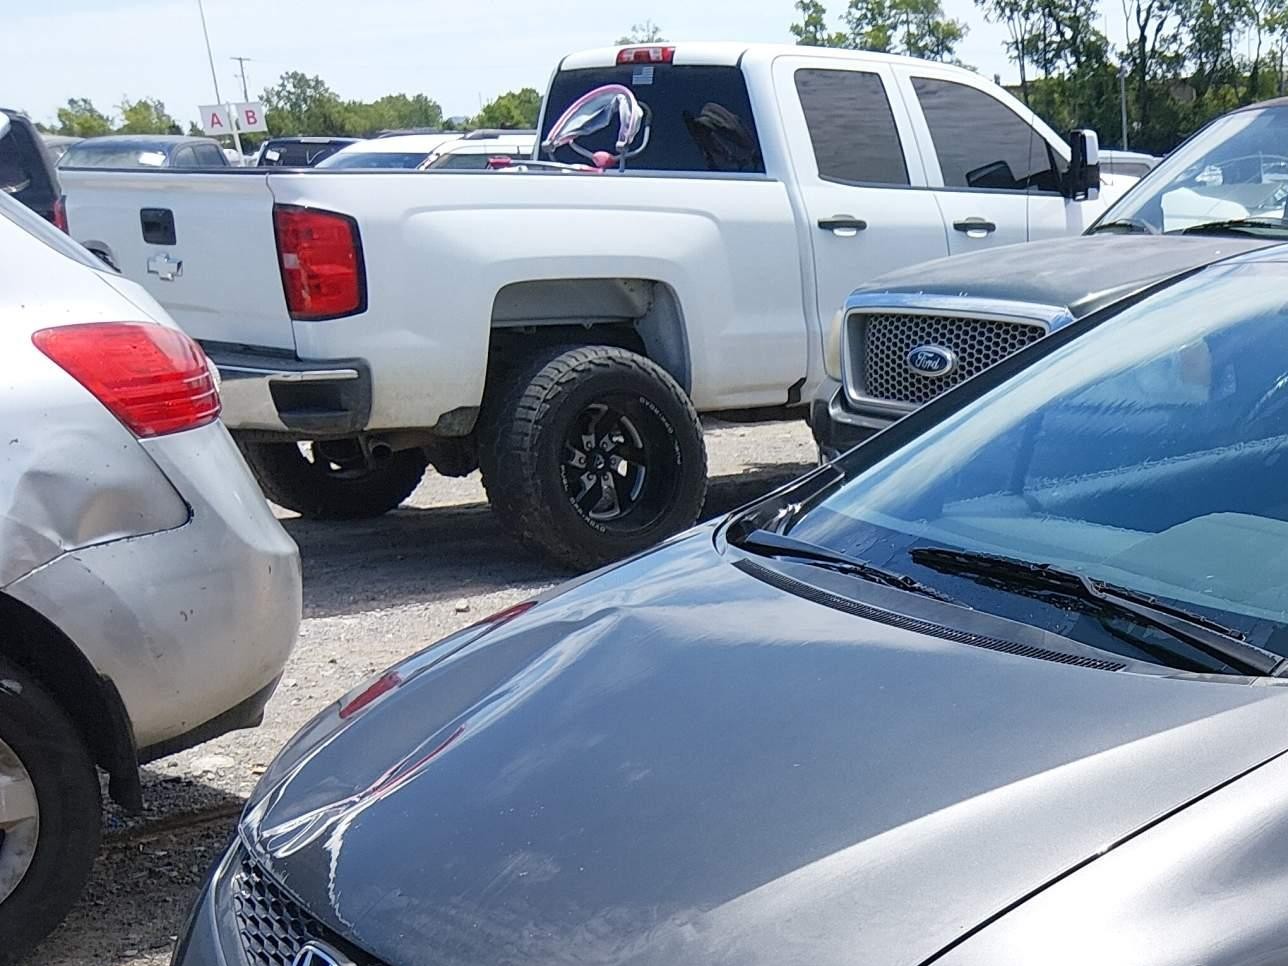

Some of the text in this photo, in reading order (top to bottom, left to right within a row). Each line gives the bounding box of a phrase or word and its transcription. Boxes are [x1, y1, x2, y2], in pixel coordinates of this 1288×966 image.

[211, 112, 223, 128] A
[245, 110, 257, 125] B
[915, 351, 941, 370] Ford
